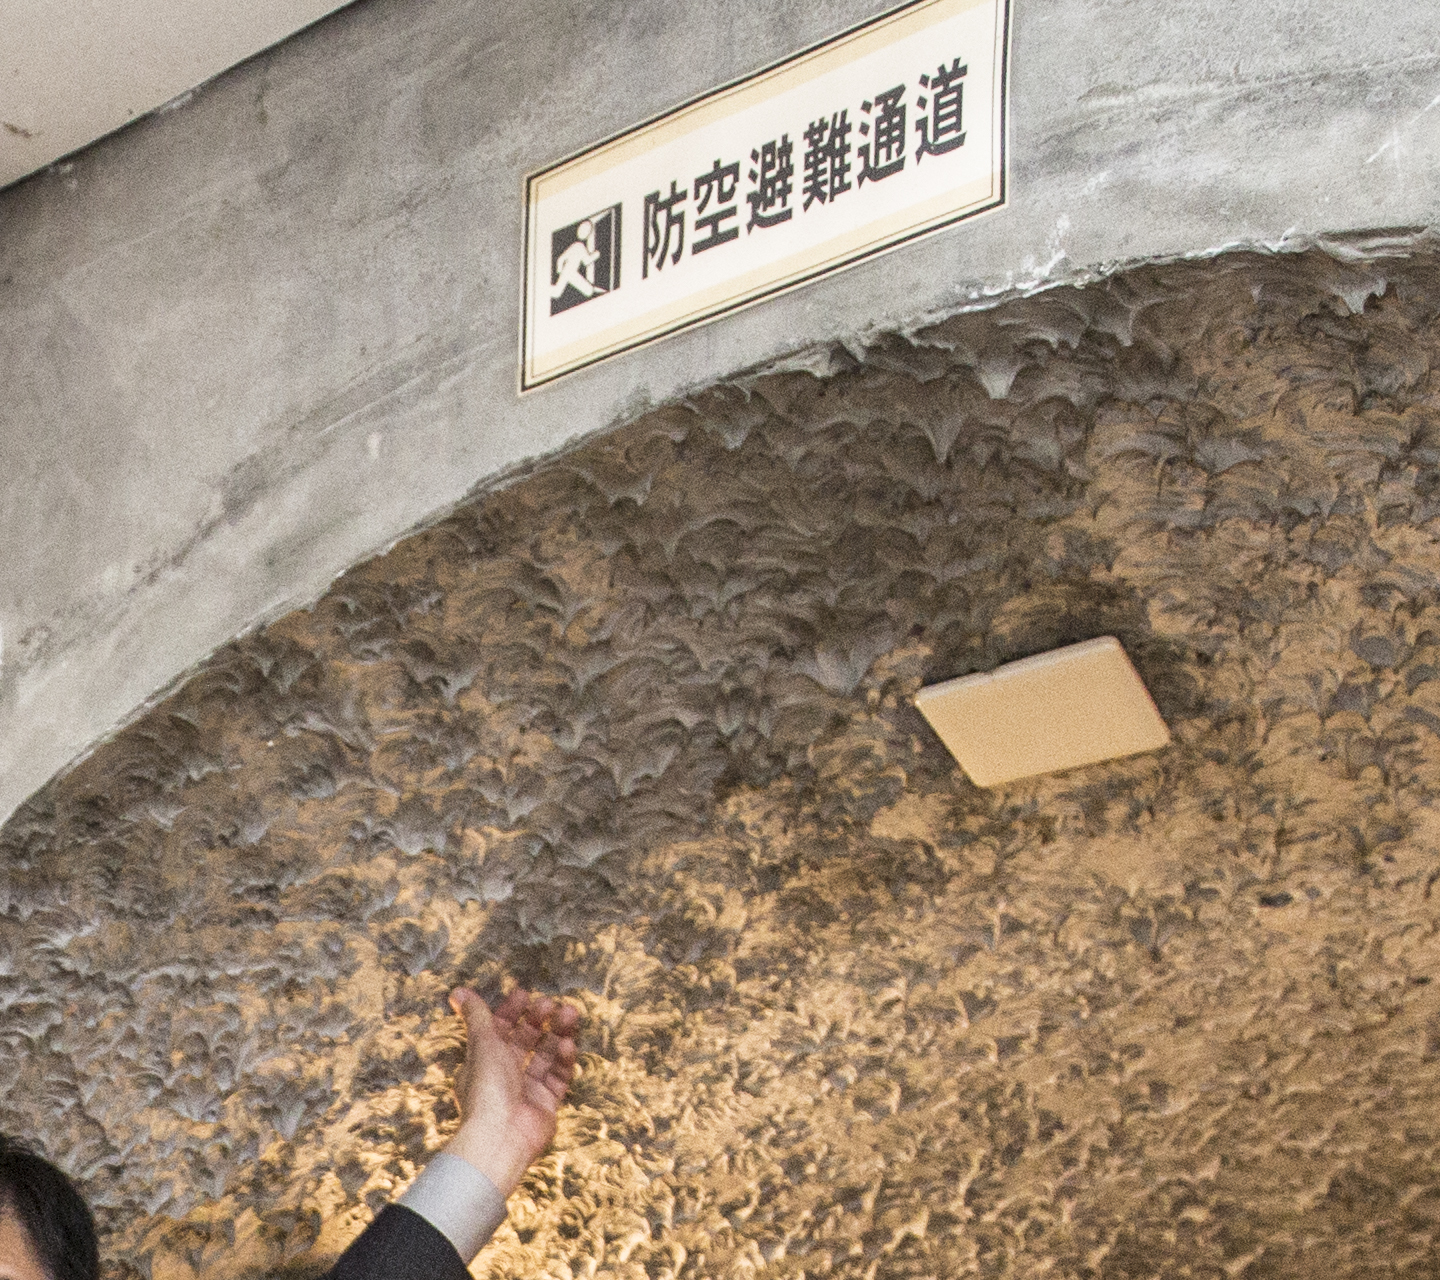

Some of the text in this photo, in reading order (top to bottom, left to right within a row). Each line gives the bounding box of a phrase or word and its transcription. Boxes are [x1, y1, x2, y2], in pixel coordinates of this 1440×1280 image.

[642, 58, 969, 279] 防空避難通道
